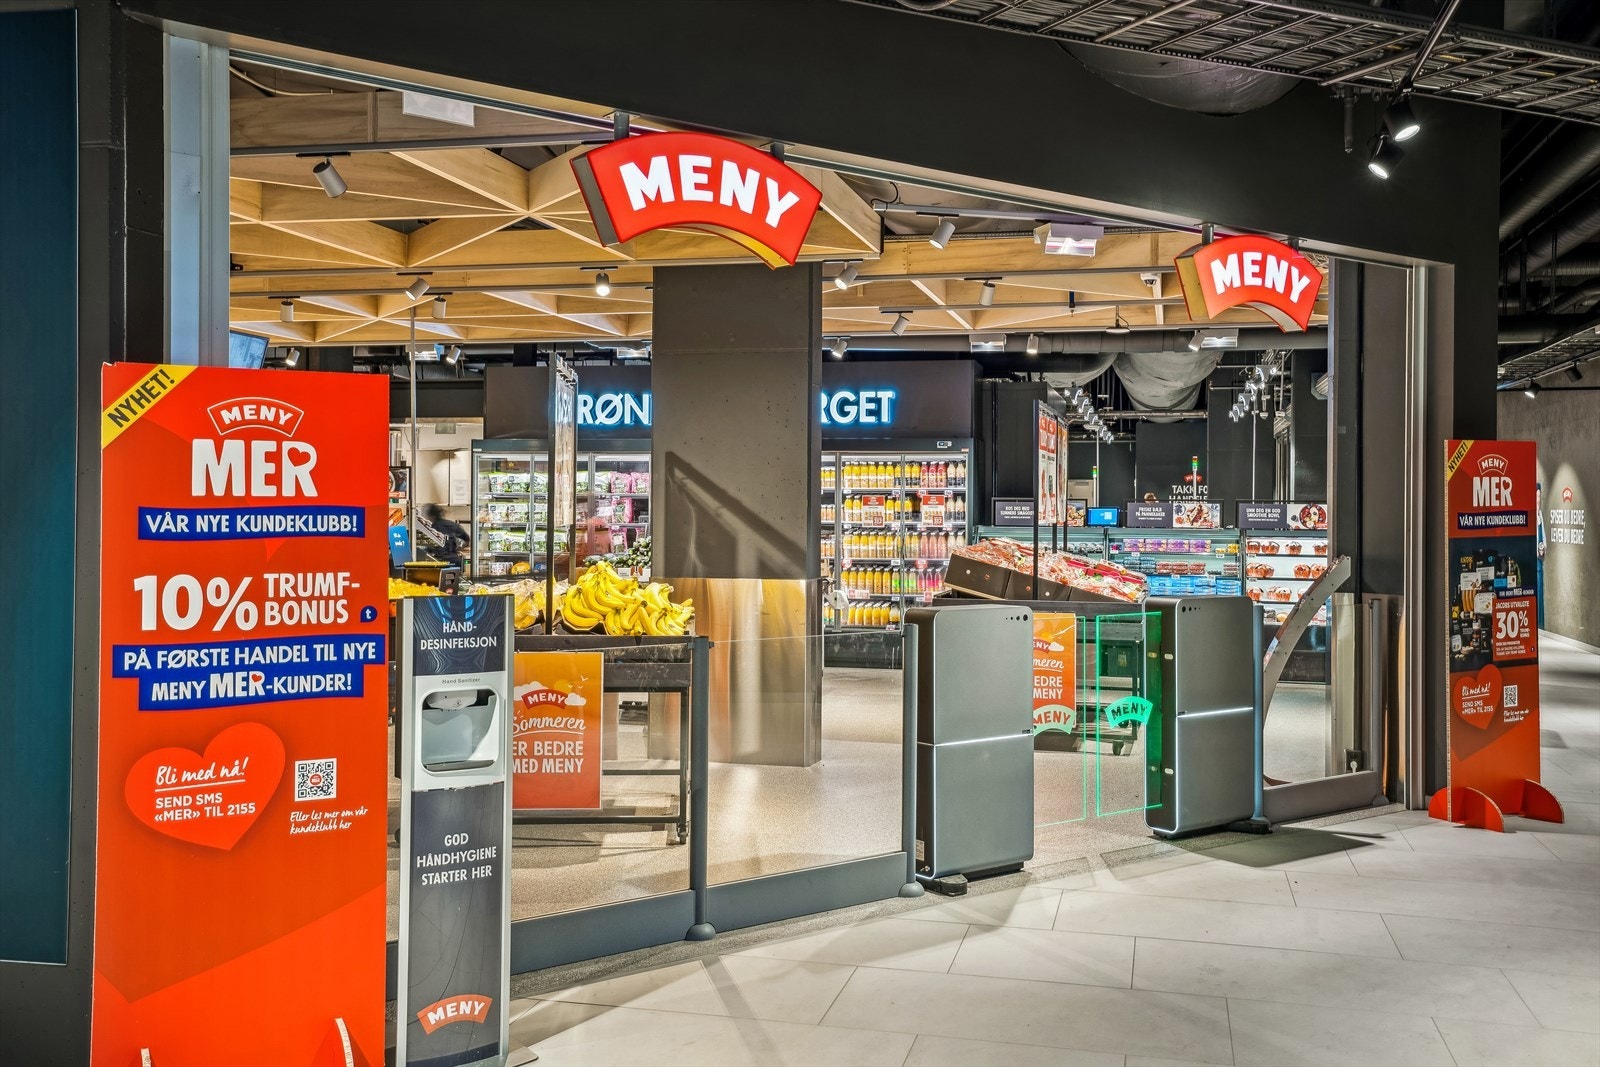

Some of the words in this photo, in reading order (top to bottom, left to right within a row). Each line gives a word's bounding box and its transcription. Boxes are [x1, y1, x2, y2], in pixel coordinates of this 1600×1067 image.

[619, 154, 800, 228] MENY
[1210, 251, 1311, 304] MENY
[107, 368, 176, 429] NYHET!
[220, 404, 294, 427] MENY
[191, 438, 318, 498] MER
[1447, 441, 1469, 473] NYHET!
[1481, 458, 1505, 470] MENY
[1472, 476, 1513, 508] MER
[146, 511, 190, 534] VÅR
[196, 514, 230, 533] NYE
[236, 513, 358, 533] KUNDEKLUBB!
[1459, 514, 1473, 527] VÅR
[1474, 515, 1485, 526] NYE
[1486, 514, 1526, 525] KUNDEKLUBB!
[264, 572, 361, 598] TRUMF-
[133, 574, 258, 632] 10%
[264, 600, 350, 626] BONUS
[442, 620, 478, 634] HÅND-
[1496, 610, 1529, 639] 30%
[420, 636, 498, 650] DESINFEKSJON
[123, 649, 151, 671] PÅ
[157, 648, 230, 669] FØRSTE
[235, 644, 309, 666] HANDEL
[313, 643, 337, 662] TIL
[343, 642, 376, 661] NYE
[151, 679, 207, 702] MENY
[209, 670, 353, 699] MER-KUNDER!
[1033, 687, 1063, 700] MENY
[527, 692, 566, 705] MENY
[1033, 711, 1071, 726] MENY
[1111, 703, 1147, 720] MENY
[512, 741, 528, 756] ER
[533, 740, 584, 756] BEDRE
[155, 766, 178, 786] Bli
[180, 762, 218, 782] med
[219, 757, 250, 780] nå!
[512, 758, 539, 774] MED
[541, 758, 585, 774] MENY
[155, 795, 193, 809] SEND
[195, 792, 223, 806] SMS
[154, 808, 201, 822] «MER»
[203, 805, 225, 818] TIL
[226, 802, 256, 816] 2155
[290, 811, 311, 822] Eller
[311, 809, 323, 820] les
[324, 811, 341, 819] mer
[341, 809, 354, 817] om
[355, 805, 369, 816] vår
[290, 819, 338, 834] kundeklubb
[339, 819, 353, 829] her
[444, 832, 470, 847] GOD
[416, 846, 498, 868] HÅNDHYGIENE
[421, 868, 468, 886] STARTER
[471, 864, 493, 880] HER
[427, 1000, 486, 1026] MENY
